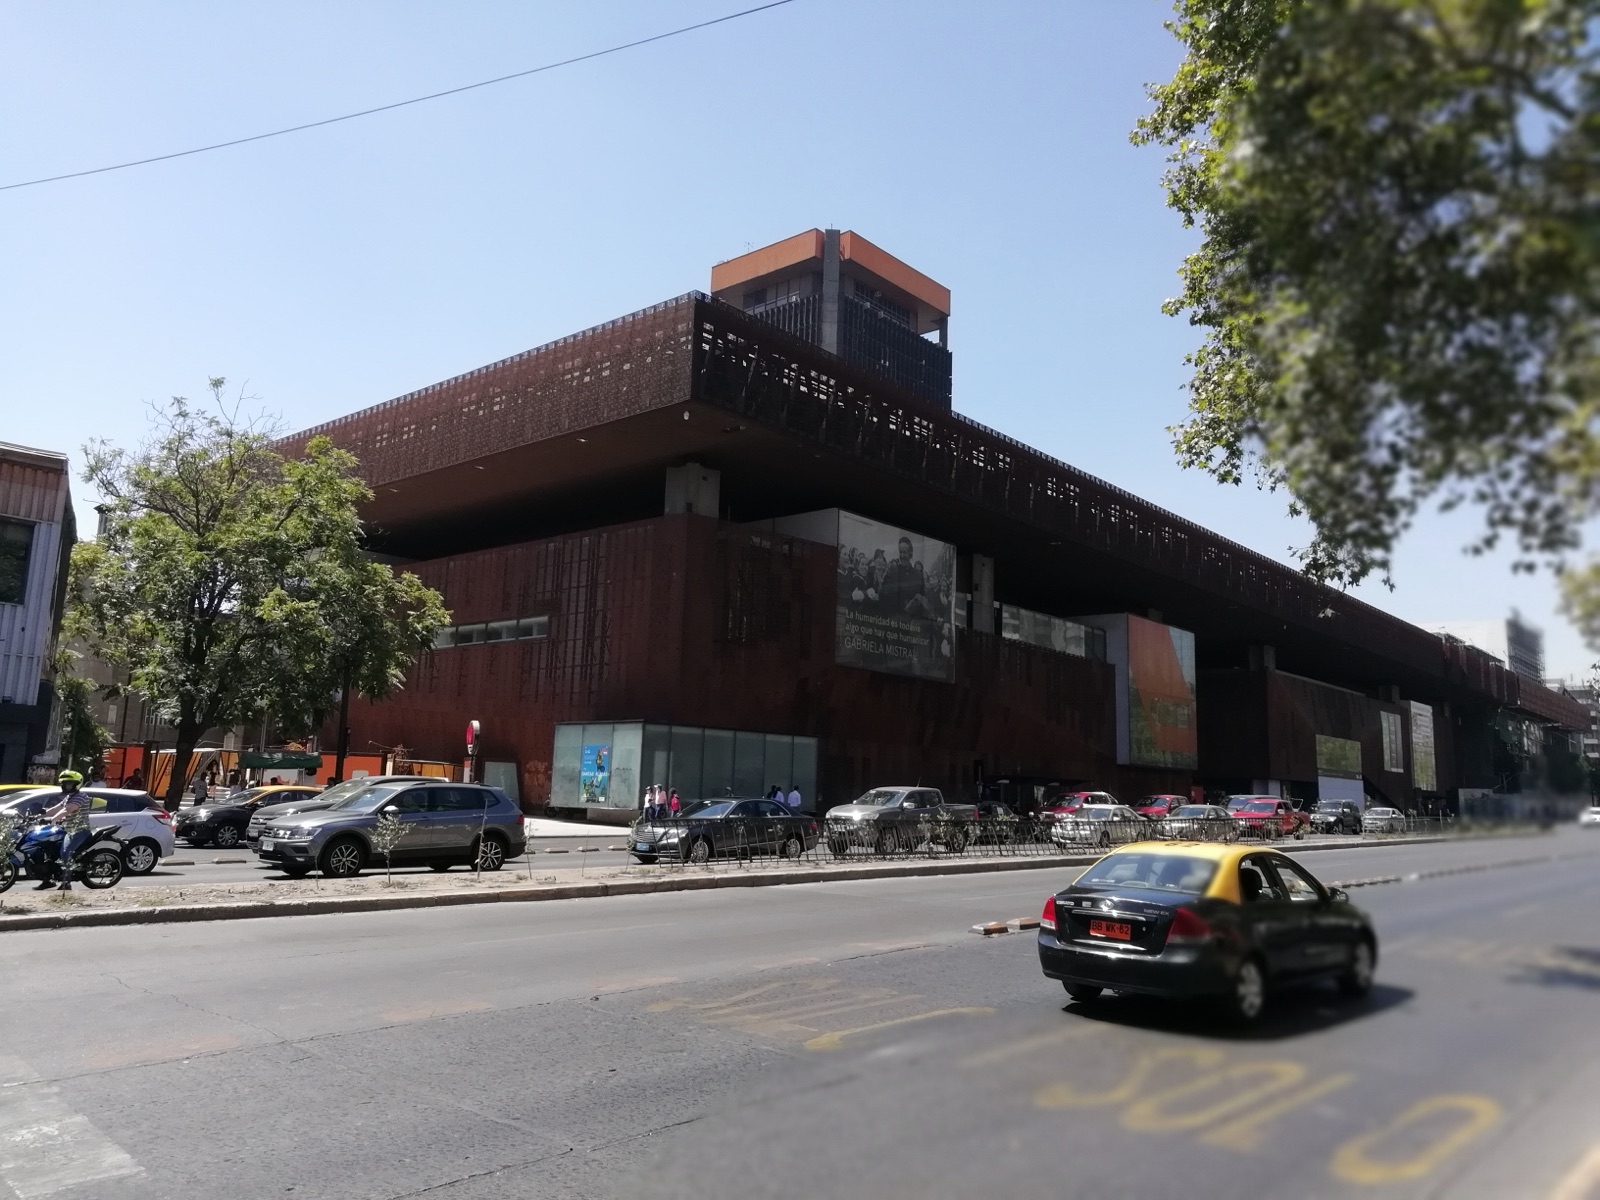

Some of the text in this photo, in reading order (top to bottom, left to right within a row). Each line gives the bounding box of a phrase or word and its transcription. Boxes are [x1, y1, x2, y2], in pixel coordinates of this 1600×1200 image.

[845, 608, 853, 619] La
[856, 610, 889, 626] humanidad
[891, 619, 898, 627] es
[845, 622, 929, 646] algo que hay que humanizar
[844, 637, 917, 660] GABRIELA MISTRAL
